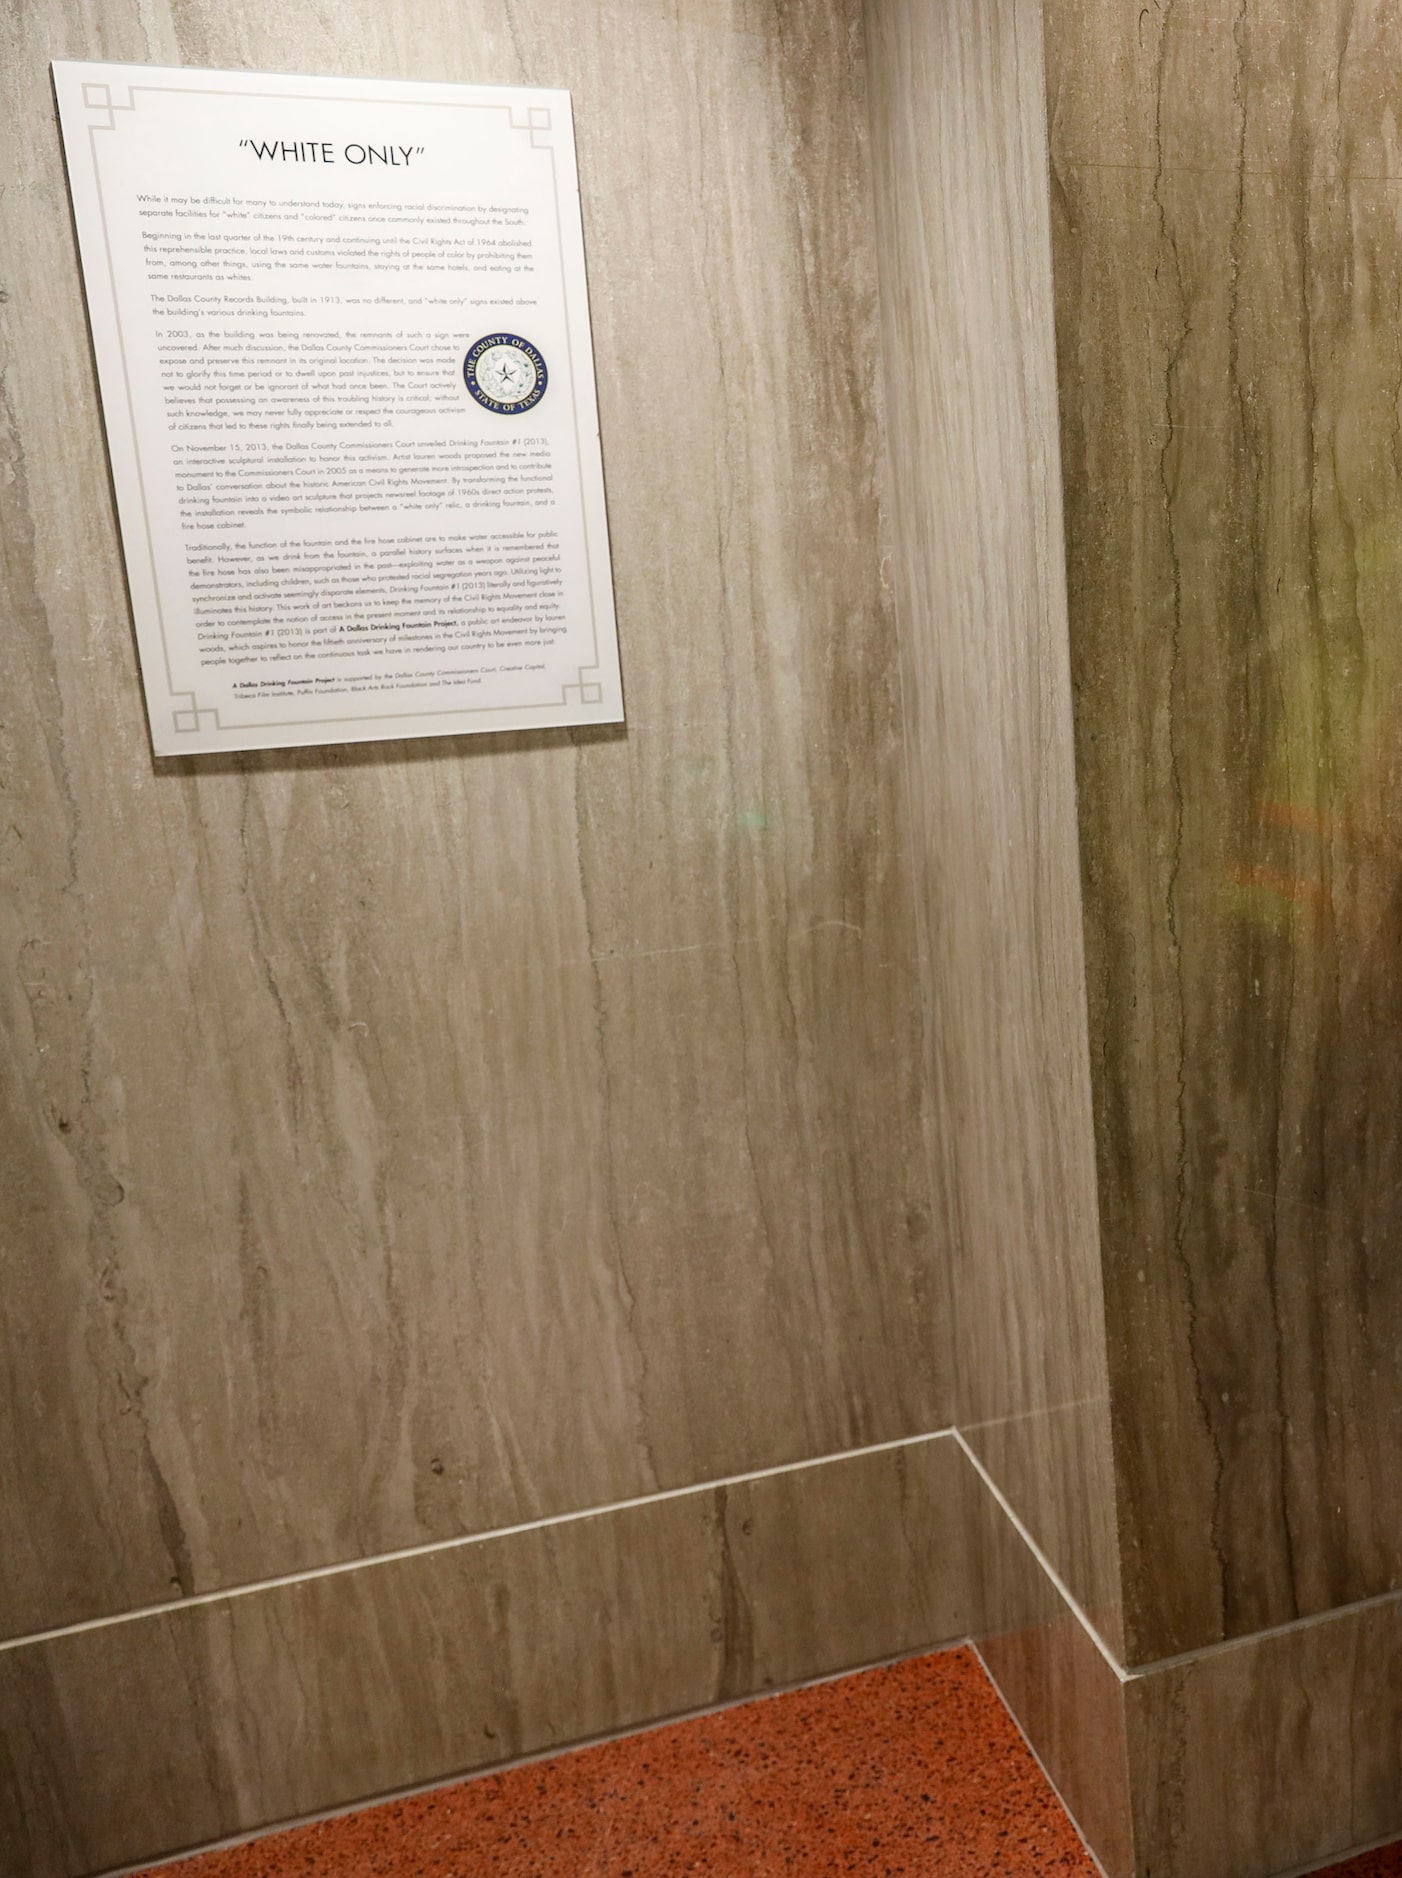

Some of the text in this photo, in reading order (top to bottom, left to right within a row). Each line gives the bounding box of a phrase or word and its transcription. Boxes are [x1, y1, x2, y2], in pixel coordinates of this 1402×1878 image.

[136, 194, 161, 205] While
[202, 196, 230, 205] difficult
[232, 197, 243, 205] for
[245, 200, 267, 208] many
[347, 202, 366, 210] signs
[368, 201, 402, 211] enforcing
[488, 205, 529, 215] designating
[138, 207, 173, 218] separate
[175, 208, 207, 218] facilities
[209, 209, 220, 218] for
[253, 212, 281, 220] citizens
[283, 212, 298, 220] and
[387, 215, 424, 224] commonly
[452, 217, 490, 226] throughout
[141, 230, 182, 241] Beginning
[193, 231, 206, 240] the
[207, 232, 221, 240] last
[223, 234, 251, 242] quarter
[262, 234, 275, 242] the
[278, 234, 294, 242] 19th
[296, 236, 324, 244] century
[326, 235, 340, 243] and
[342, 237, 381, 245] continuing
[430, 237, 452, 247] Rights
[477, 238, 496, 246] 1964
[150, 294, 164, 304] The
[167, 294, 192, 303] Dallas
[193, 294, 221, 304] County
[223, 295, 254, 303] Records
[515, 297, 537, 305] above
[152, 306, 165, 316] the
[206, 308, 235, 318] various
[236, 307, 268, 318] drinking
[202, 343, 221, 351] After
[223, 343, 243, 351] much
[288, 343, 299, 351] the
[326, 343, 352, 352] County
[353, 343, 407, 351] Commissioners
[409, 343, 429, 351] Court
[467, 337, 544, 379] THE COUNTY OF DALLAS
[164, 396, 196, 404] believes
[198, 395, 213, 404] that
[215, 396, 256, 405] possessing
[337, 394, 369, 404] troubling
[371, 394, 395, 403] history
[475, 389, 499, 410] STATE
[518, 389, 541, 409] TEXAS
[186, 443, 227, 452] November
[271, 442, 284, 450] the
[285, 442, 309, 450] Dallas
[310, 442, 337, 451] County
[339, 441, 393, 449] Commissioners
[394, 440, 415, 448] Court
[449, 439, 478, 448] Drinking
[197, 632, 228, 640] Drinking
[277, 628, 302, 637] (2013)
[312, 627, 327, 635] part
[346, 624, 368, 632] Dallas
[370, 622, 400, 631] Drinking
[401, 621, 432, 629] Fountain
[467, 618, 487, 626] public
